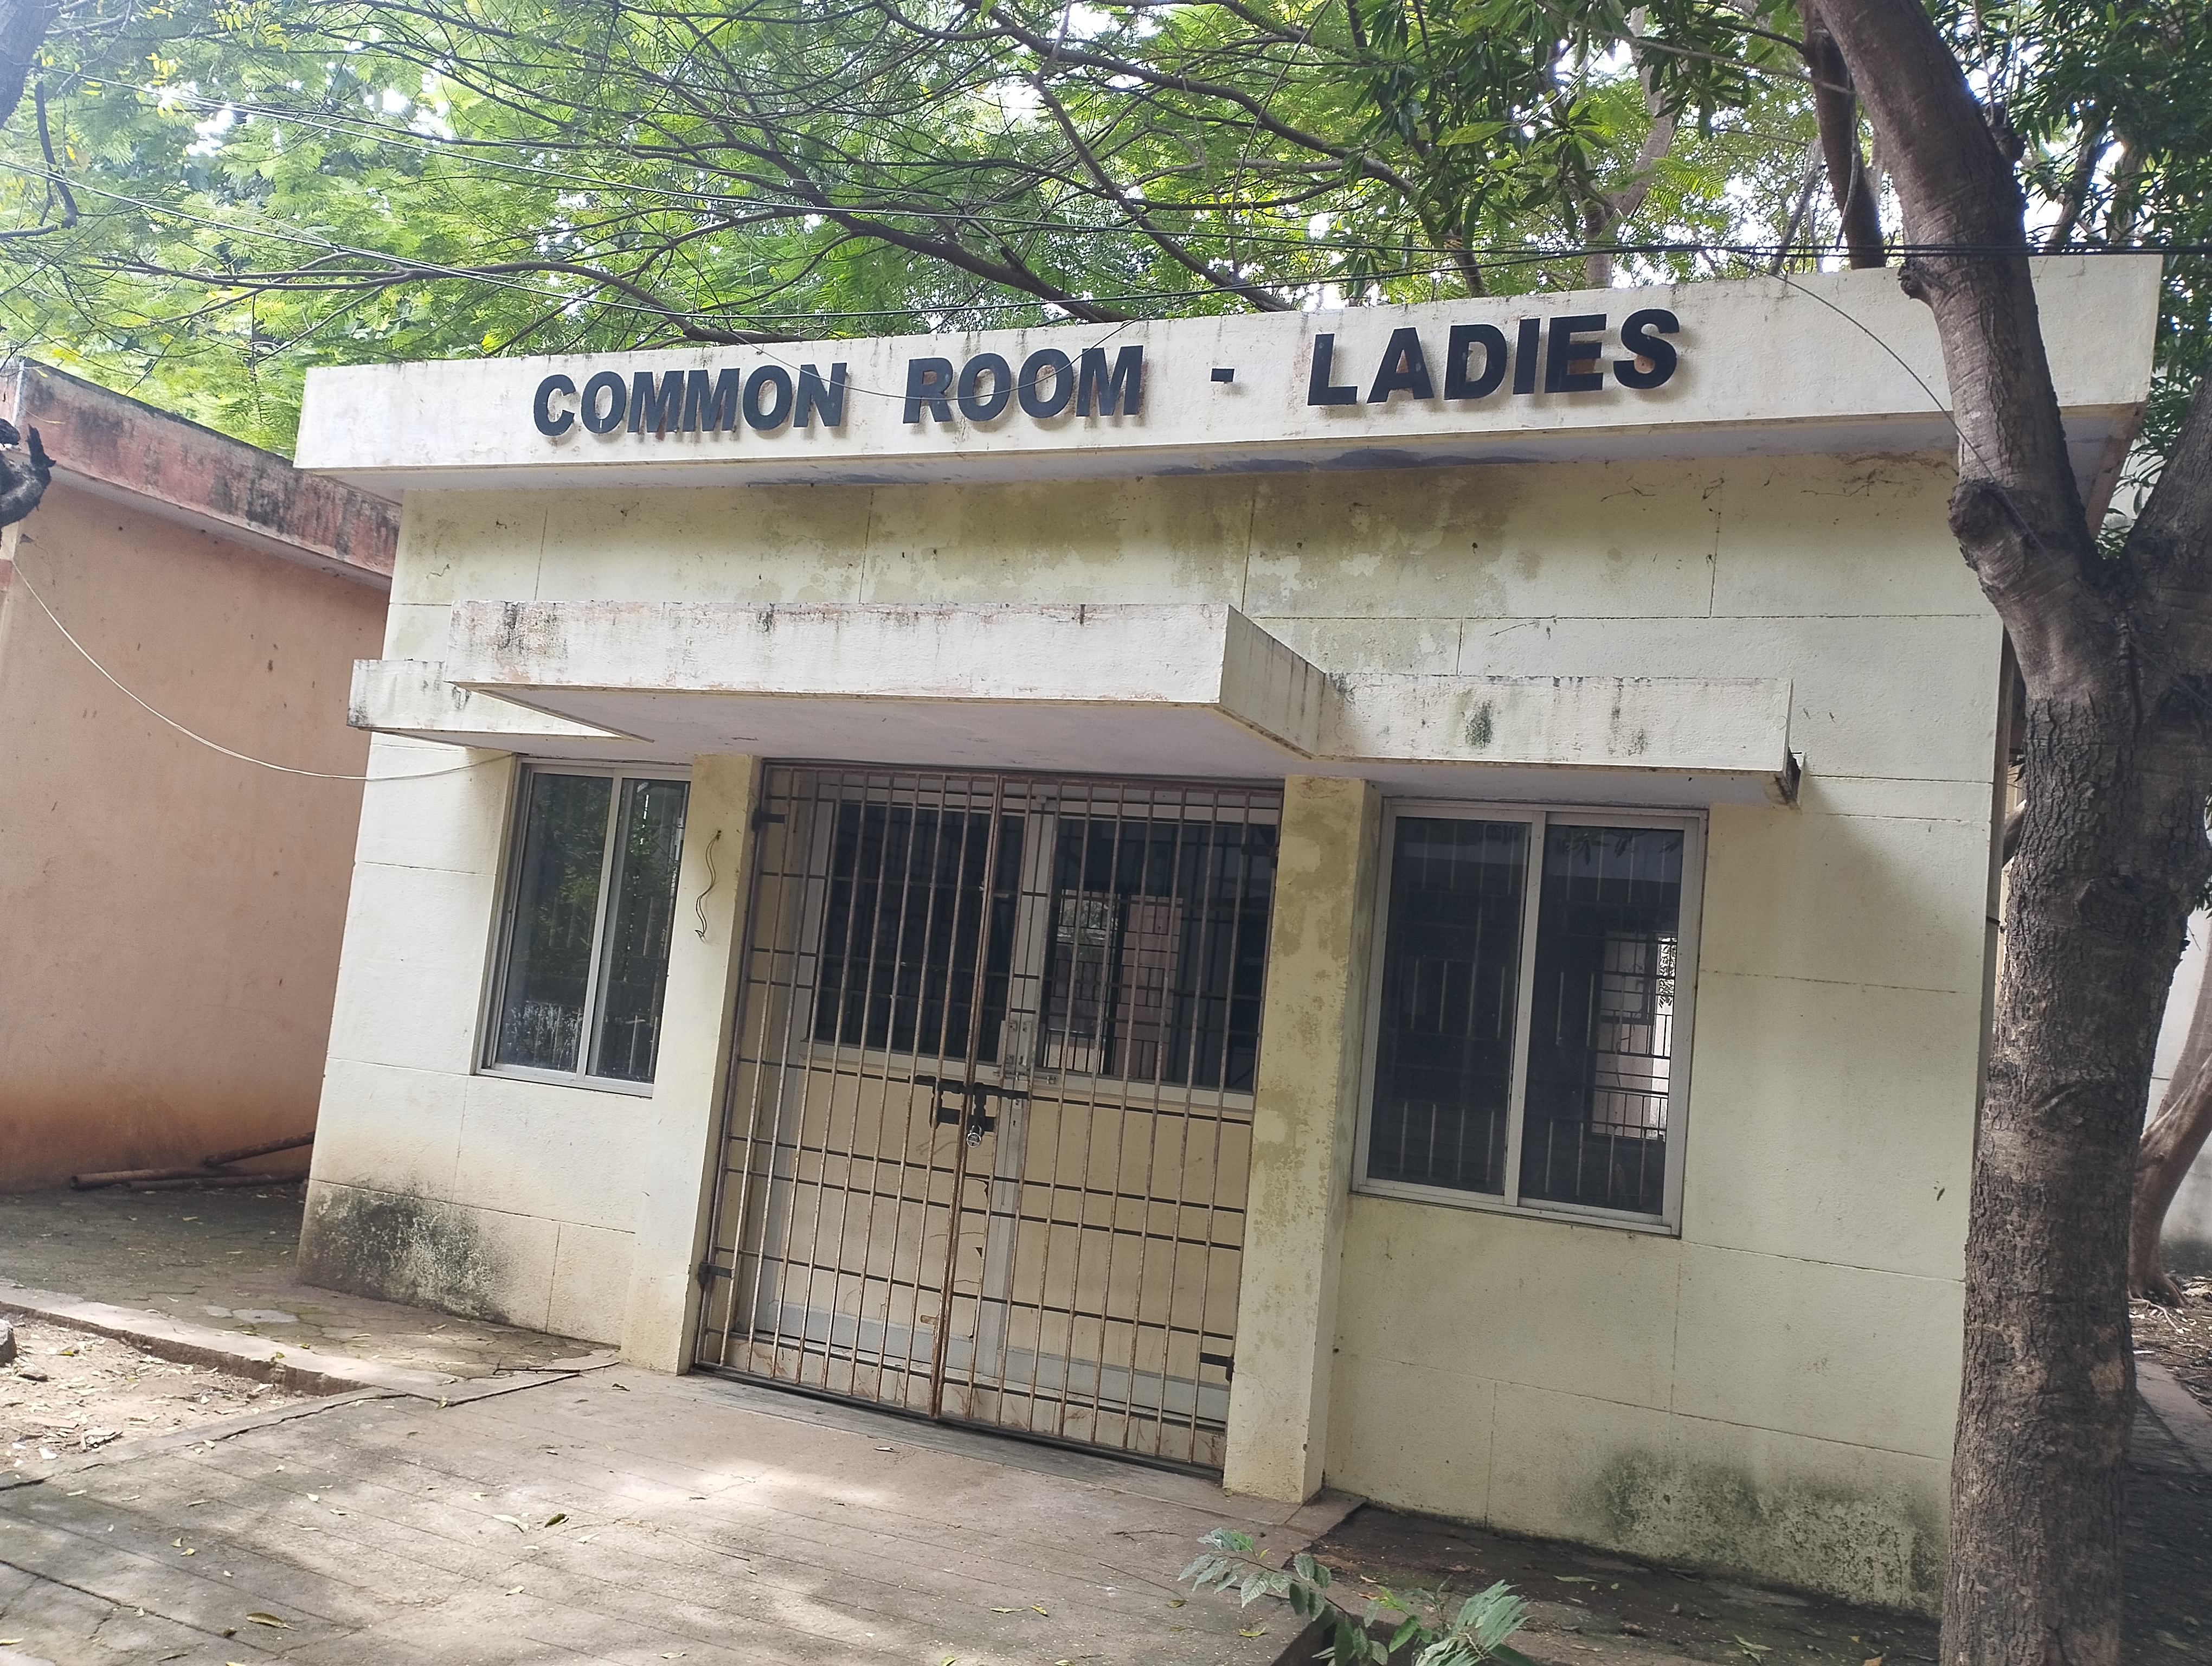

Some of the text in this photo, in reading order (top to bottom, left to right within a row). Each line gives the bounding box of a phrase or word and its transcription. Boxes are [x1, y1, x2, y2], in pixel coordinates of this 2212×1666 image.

[533, 309, 1679, 436] COMMON ROOM - LADIES
